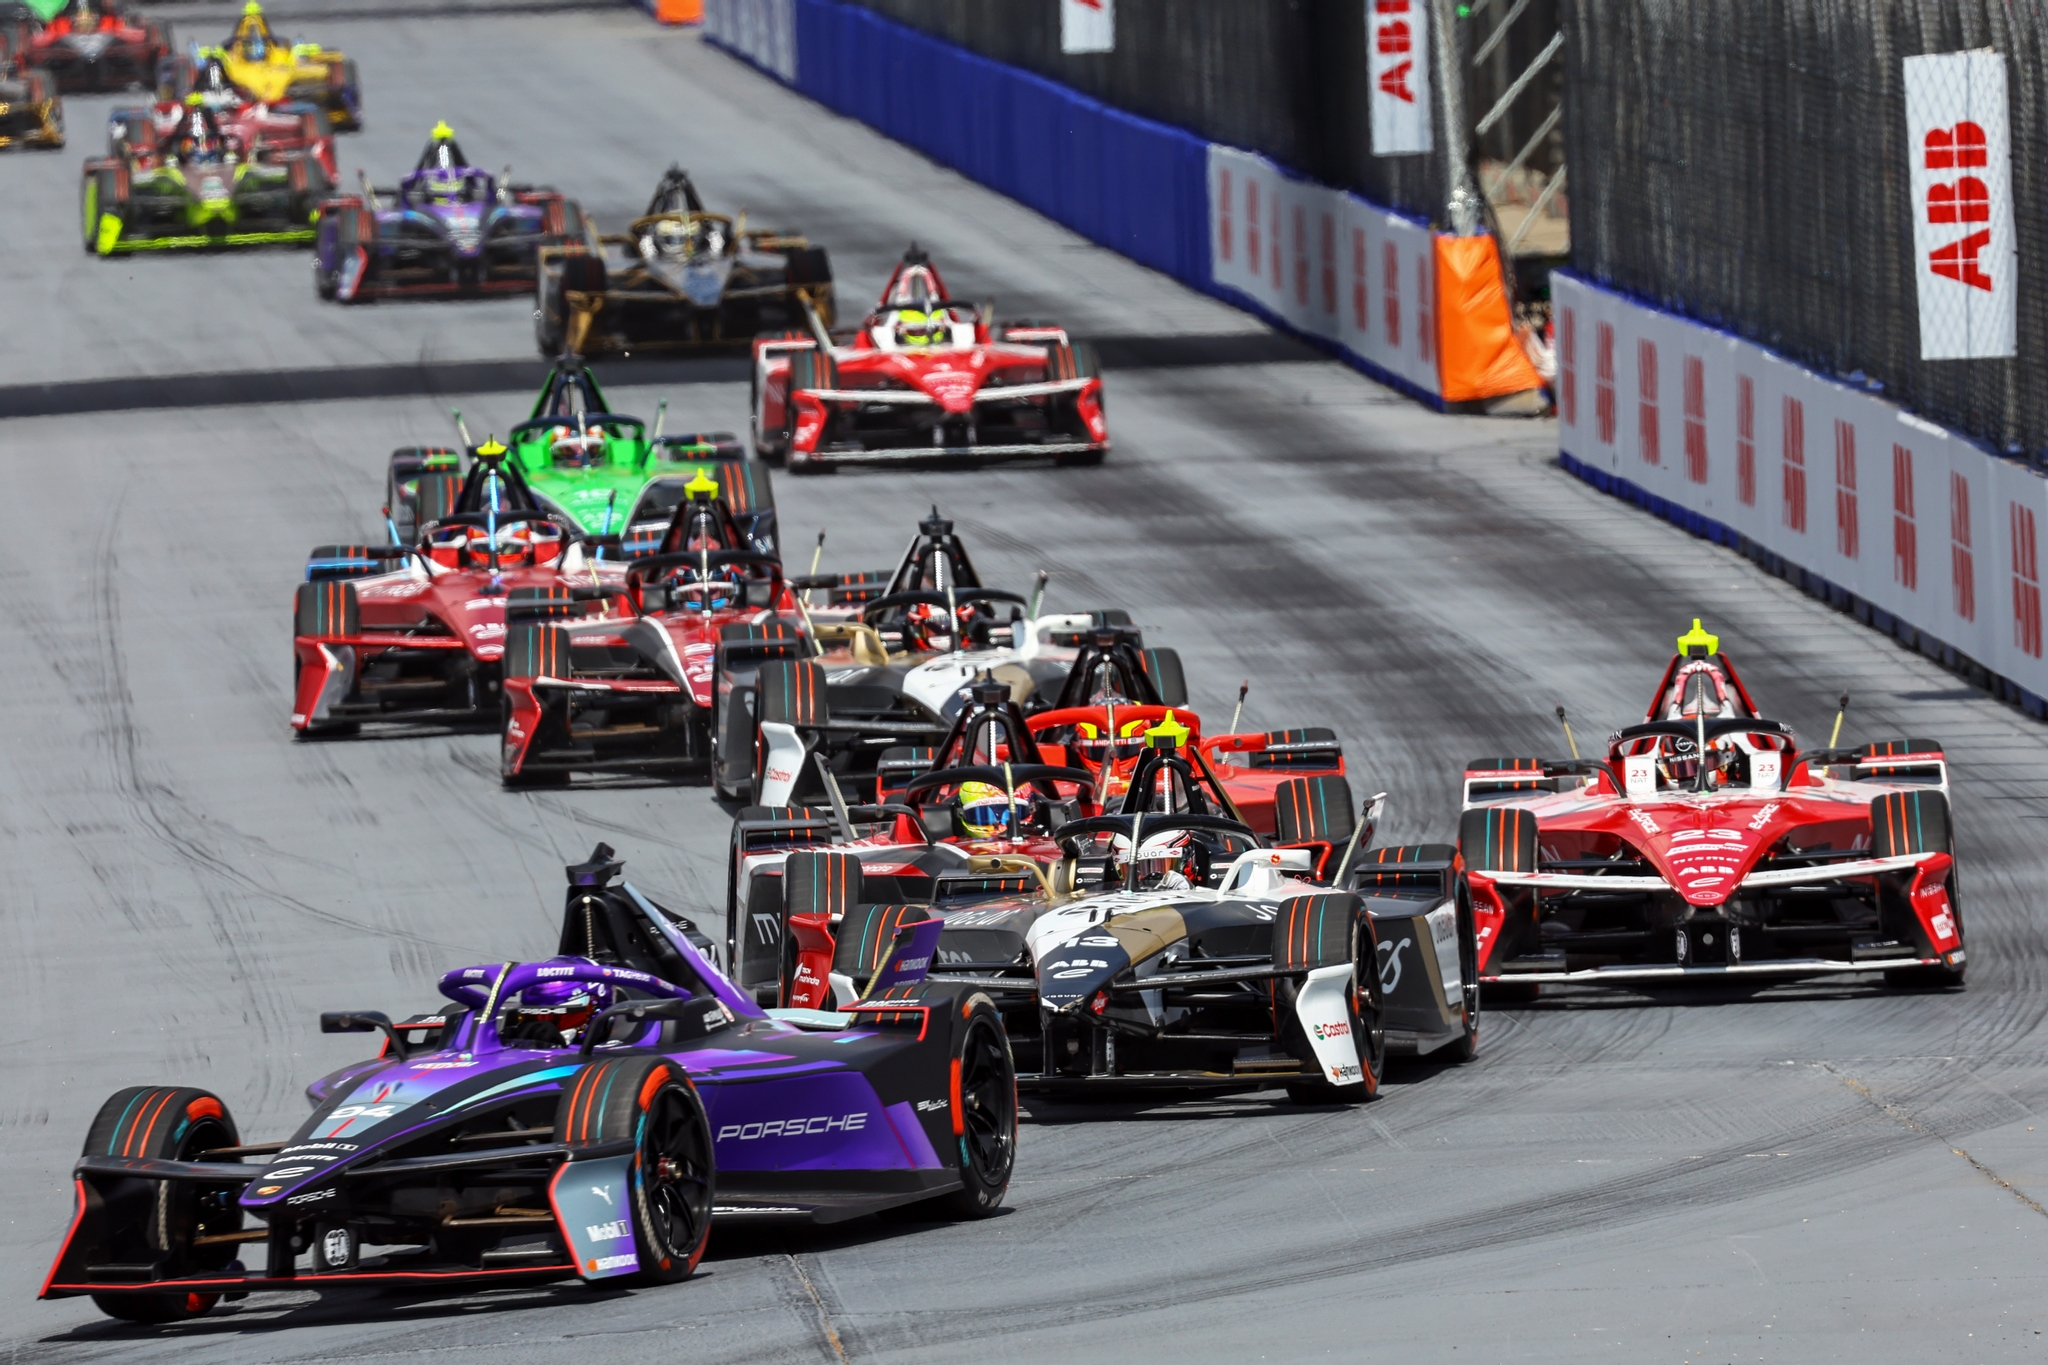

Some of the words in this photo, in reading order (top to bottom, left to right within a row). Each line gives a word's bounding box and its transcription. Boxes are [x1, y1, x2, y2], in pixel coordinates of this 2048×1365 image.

[1925, 120, 1994, 292] ABB
[1631, 769, 1648, 777] 23
[1758, 764, 1775, 772] 23
[1671, 829, 1742, 842] 23
[1678, 866, 1735, 876] ABB
[1065, 936, 1119, 948] 13
[1047, 959, 1108, 970] ABB
[537, 967, 575, 977] LOCTITE
[1322, 1021, 1350, 1038] Castrol
[327, 1105, 396, 1120] 94
[716, 1112, 868, 1143] PORSCHE
[281, 1143, 336, 1154] Mobil
[286, 1188, 337, 1206] PORSCHE
[586, 1221, 619, 1242] Mobil
